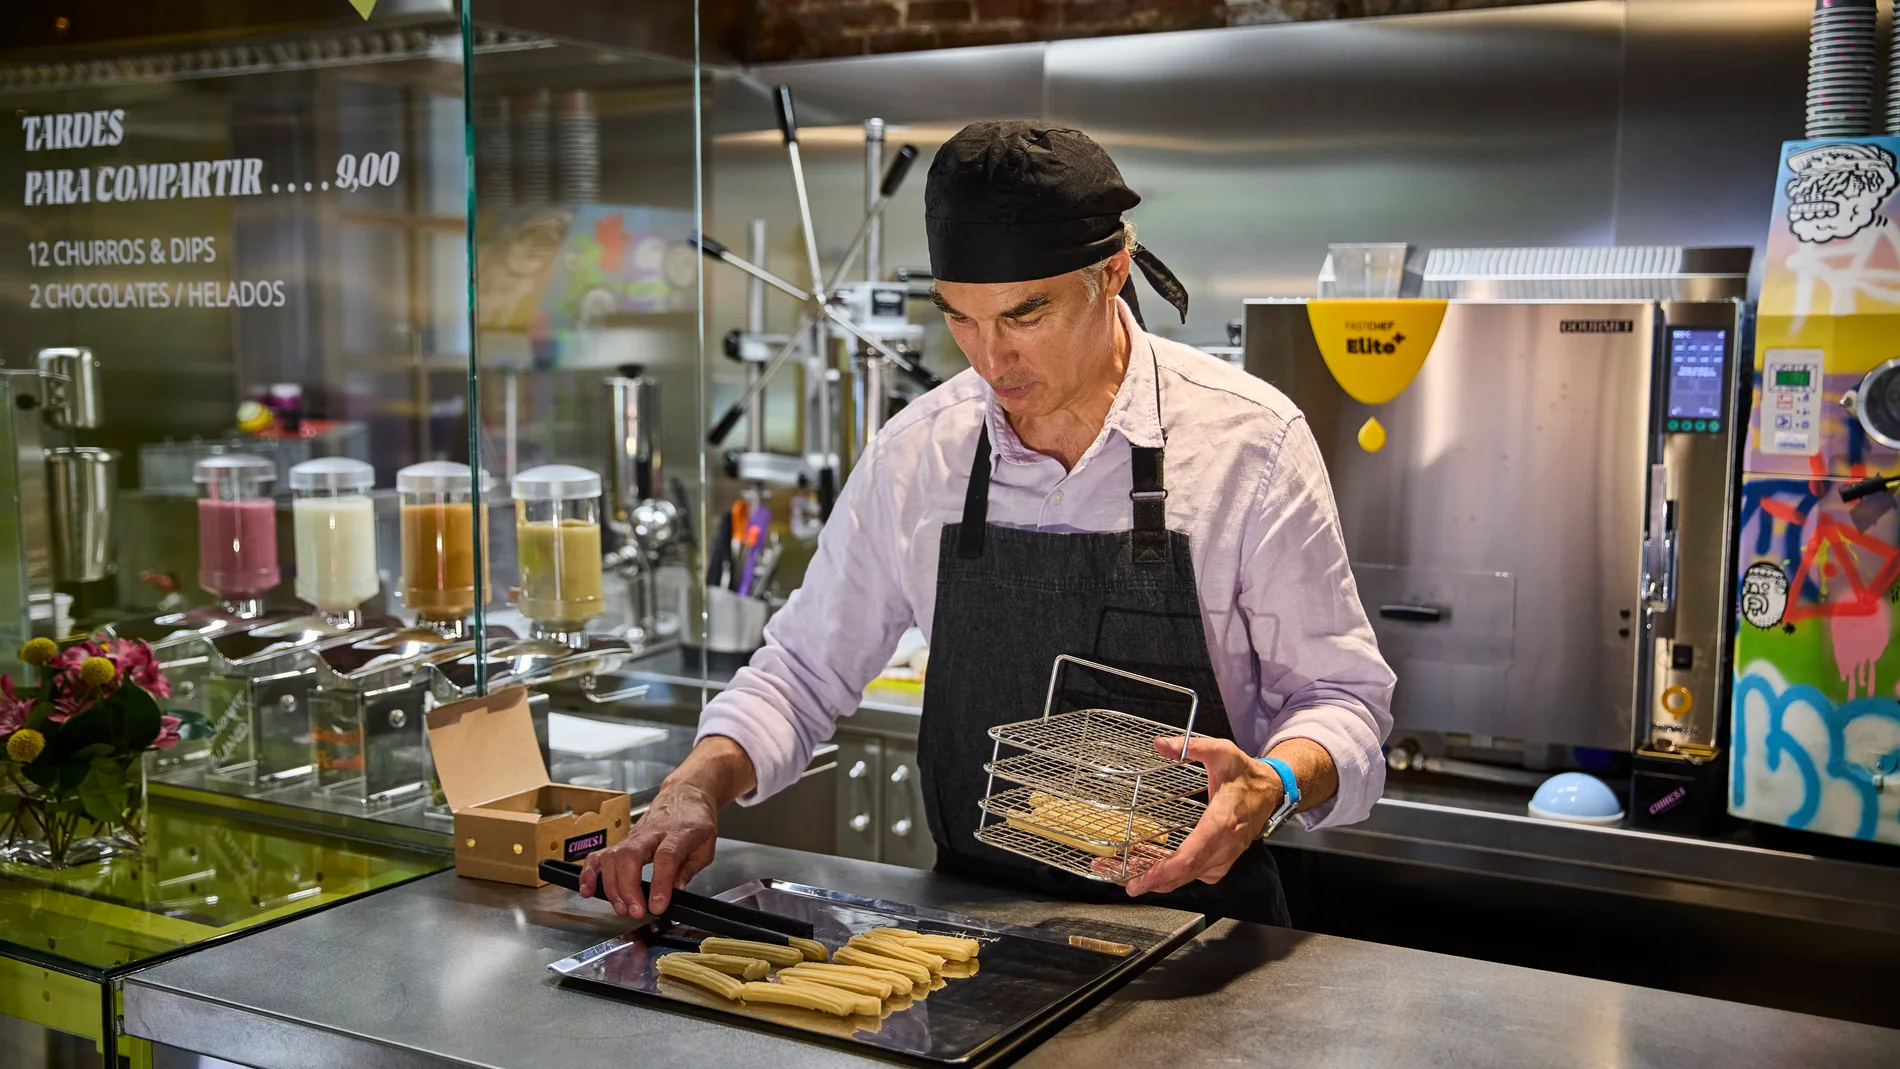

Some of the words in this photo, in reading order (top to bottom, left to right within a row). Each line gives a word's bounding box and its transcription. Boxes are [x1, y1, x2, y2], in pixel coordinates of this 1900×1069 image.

[22, 108, 125, 151] TARDES
[24, 168, 91, 206] PARA
[96, 158, 263, 203] COMPARTIR
[335, 151, 400, 193] 9,00
[28, 241, 50, 267] 12
[53, 238, 146, 266] CHURROS
[150, 237, 166, 264] &
[170, 236, 216, 263] DIPS
[29, 283, 42, 308] 2
[45, 281, 170, 308] CHOCOLATES
[174, 281, 183, 308] /
[187, 280, 286, 307] HELADOS
